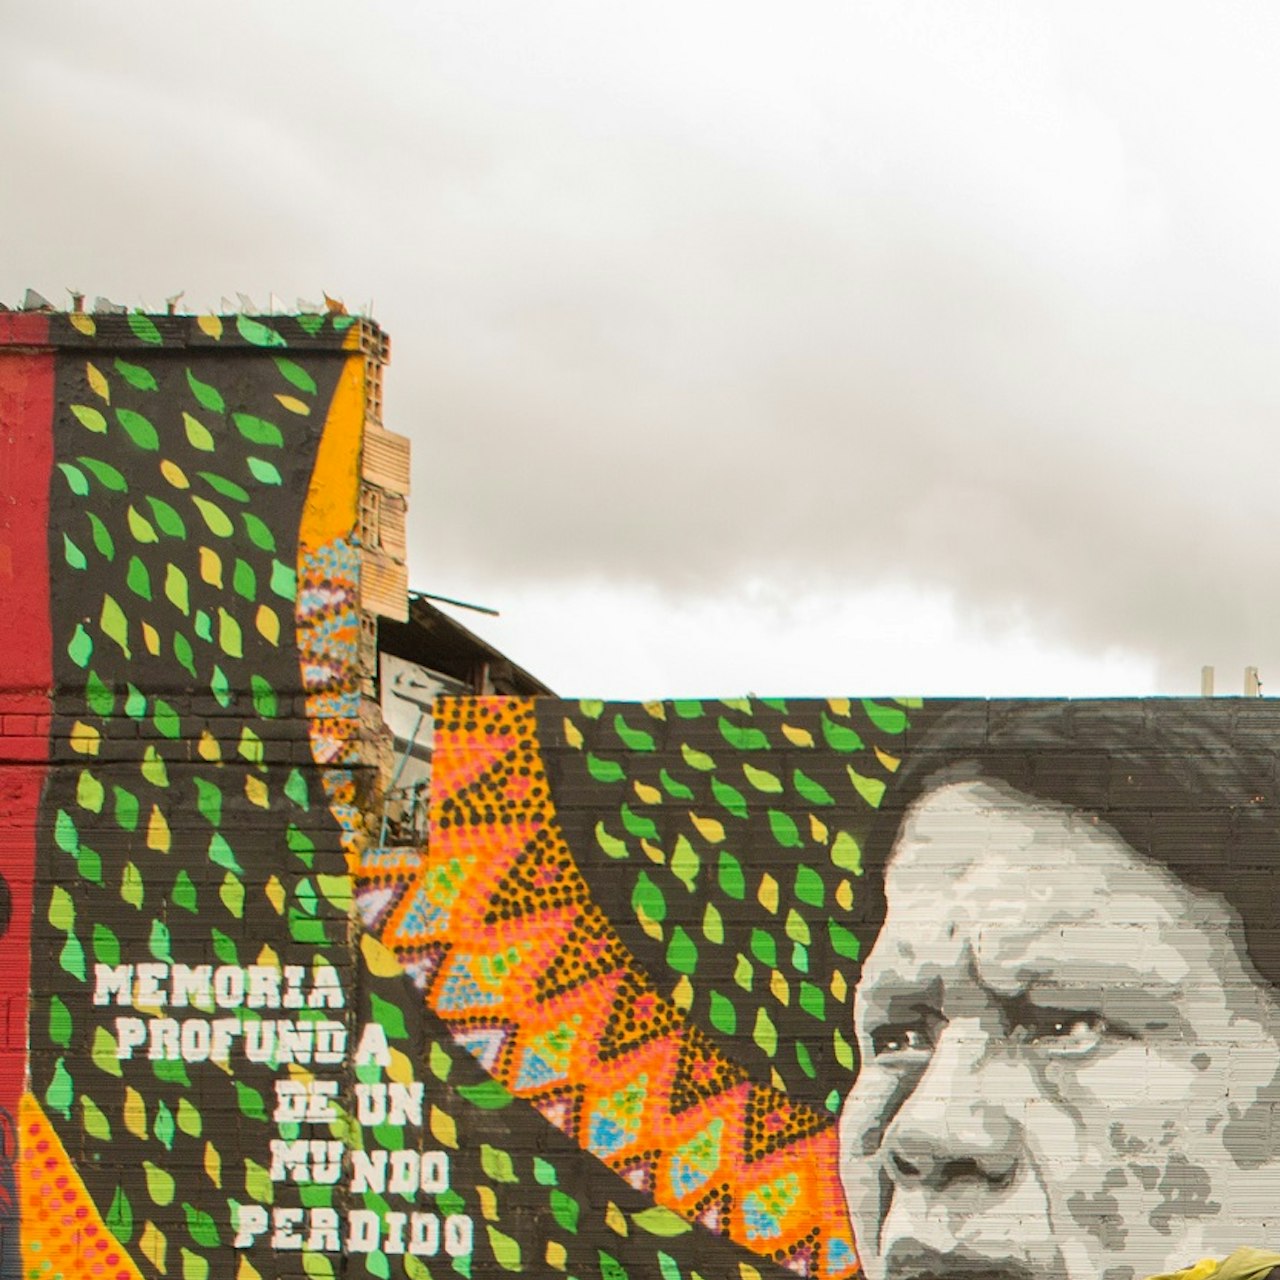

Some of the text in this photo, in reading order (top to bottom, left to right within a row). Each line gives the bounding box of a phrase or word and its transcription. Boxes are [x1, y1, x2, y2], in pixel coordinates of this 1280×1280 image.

[93, 963, 345, 1008] MEMORIA
[115, 1017, 391, 1067] PROFUNDA
[274, 1080, 424, 1126] DE UN
[270, 1139, 450, 1194] MUNDO
[234, 1204, 474, 1257] PERDIDO
